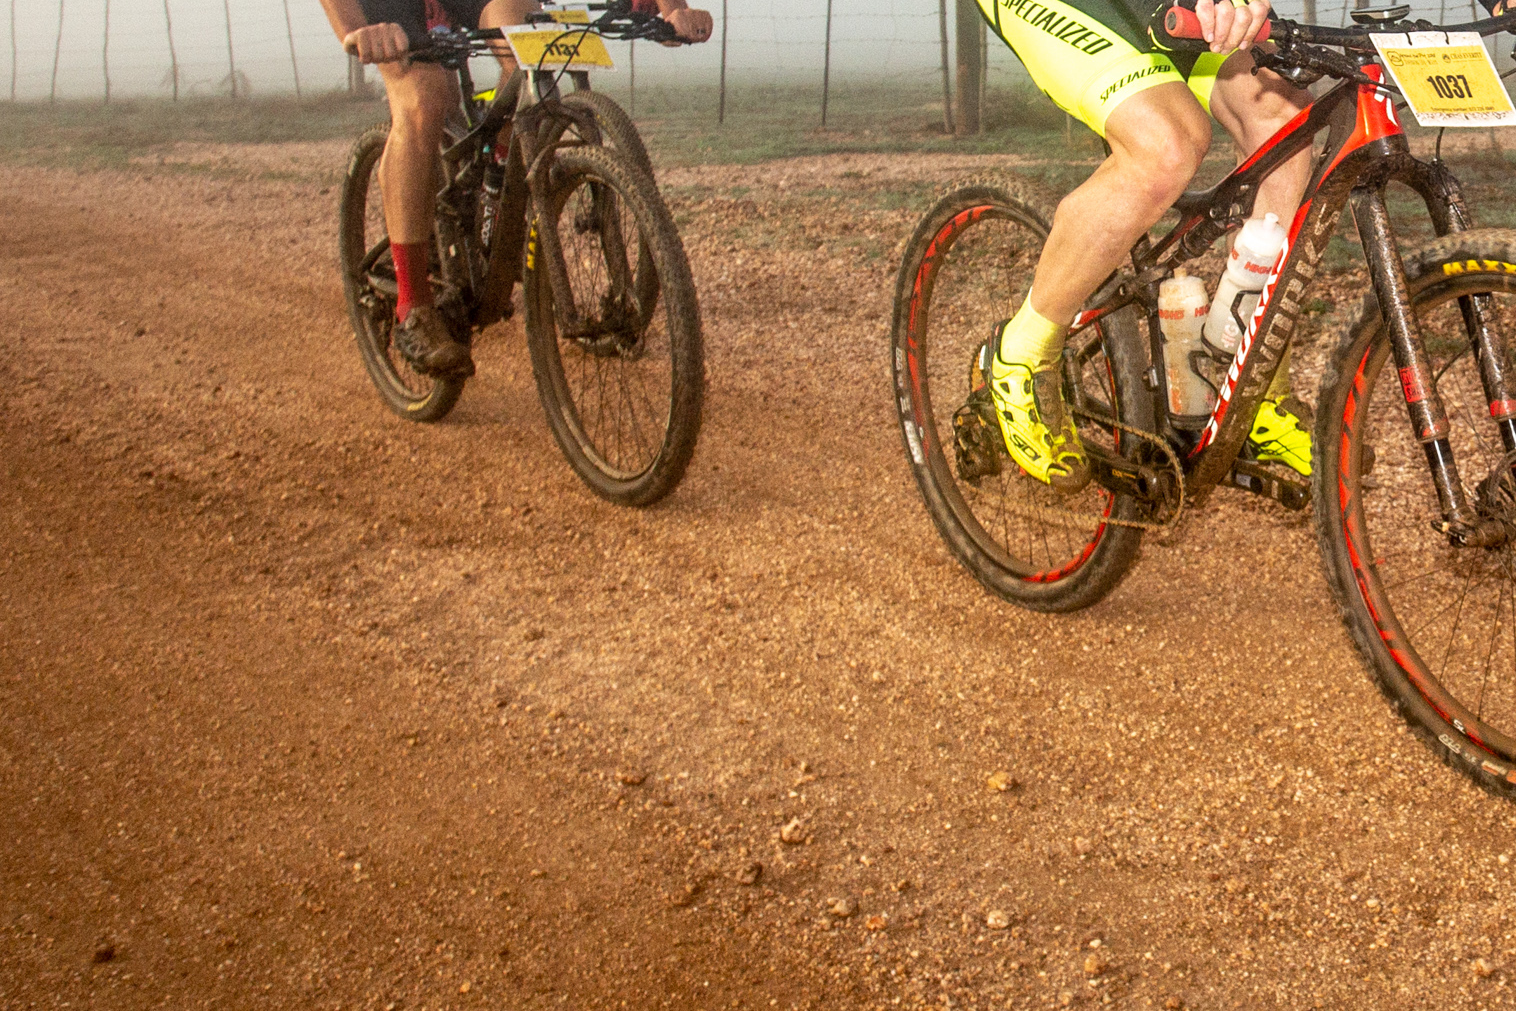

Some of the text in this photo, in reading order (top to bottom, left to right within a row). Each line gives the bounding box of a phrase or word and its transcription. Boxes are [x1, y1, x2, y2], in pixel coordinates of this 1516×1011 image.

[1100, 65, 1171, 106] SPECIALIZED
[1427, 74, 1473, 99] 1037
[1009, 433, 1042, 462] SIDI
